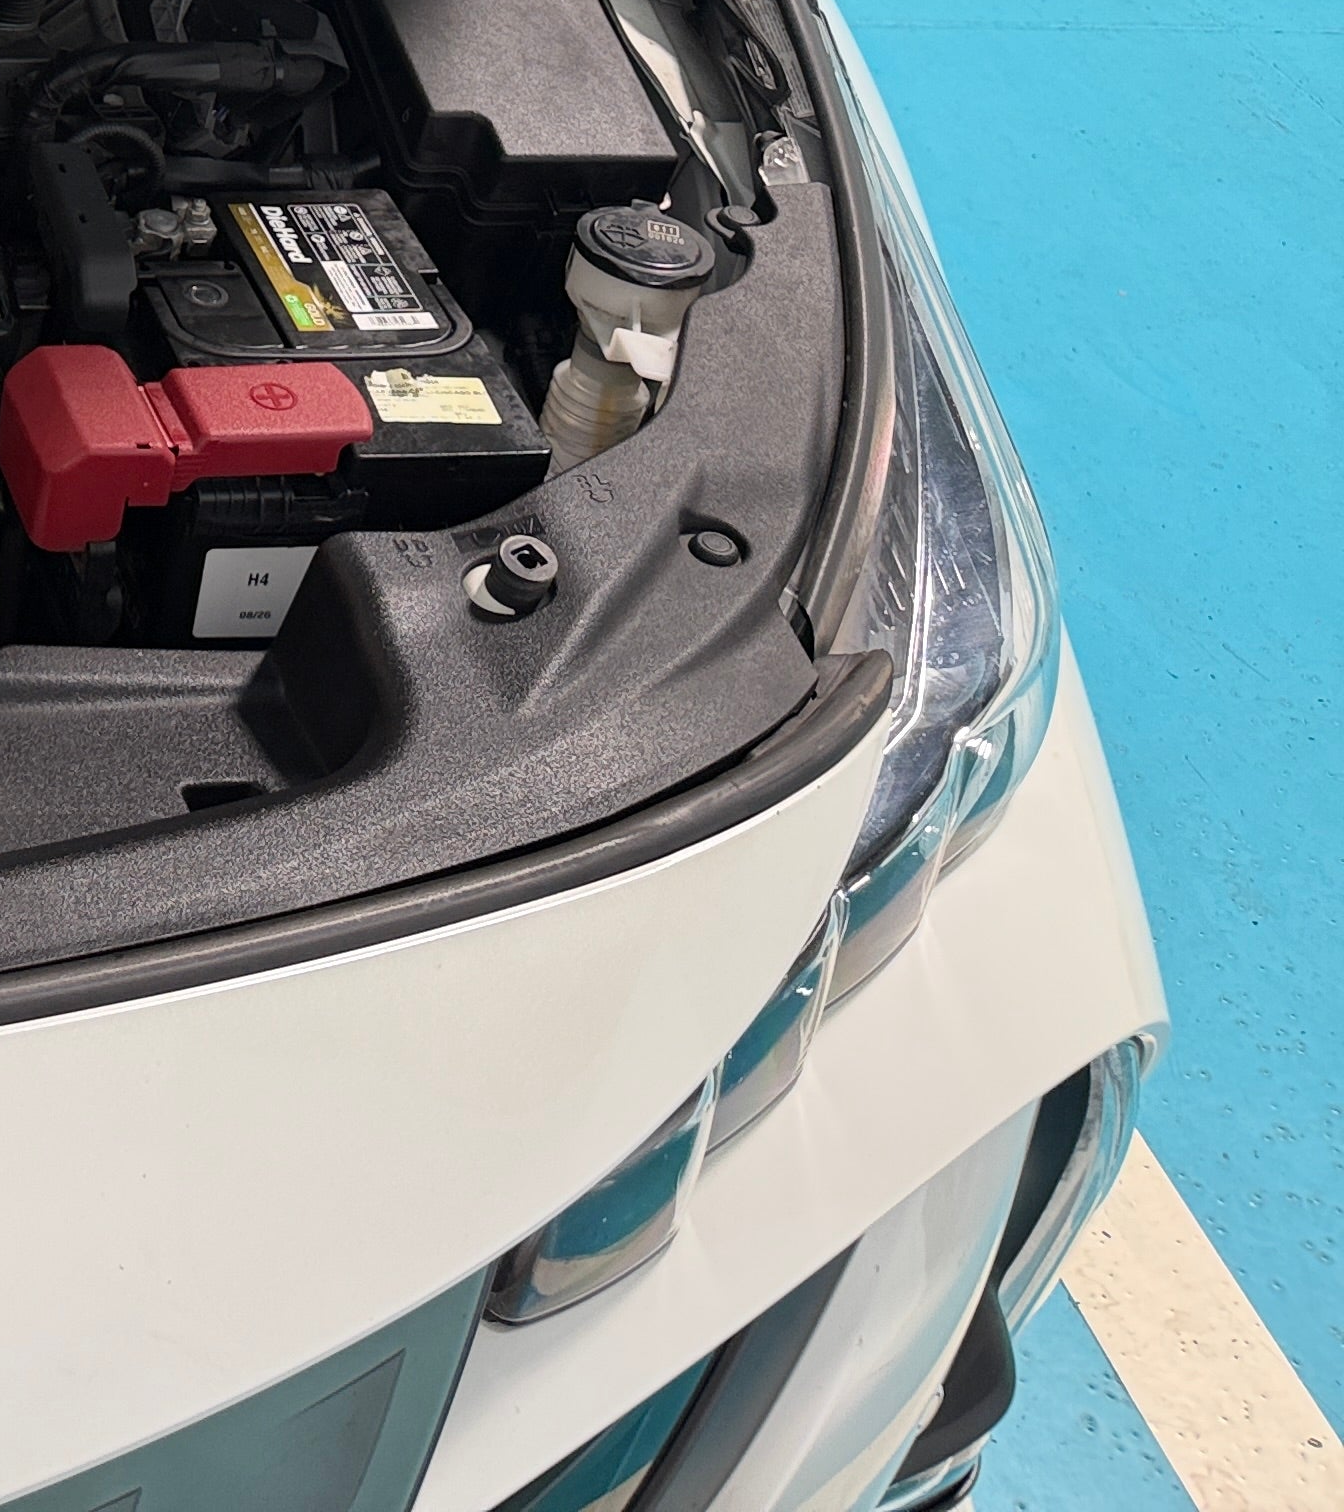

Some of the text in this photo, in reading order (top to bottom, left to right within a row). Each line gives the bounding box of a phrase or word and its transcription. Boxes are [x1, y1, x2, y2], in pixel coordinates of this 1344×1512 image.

[260, 205, 313, 264] DieHard
[303, 302, 327, 327] GOLD
[247, 572, 270, 587] H4
